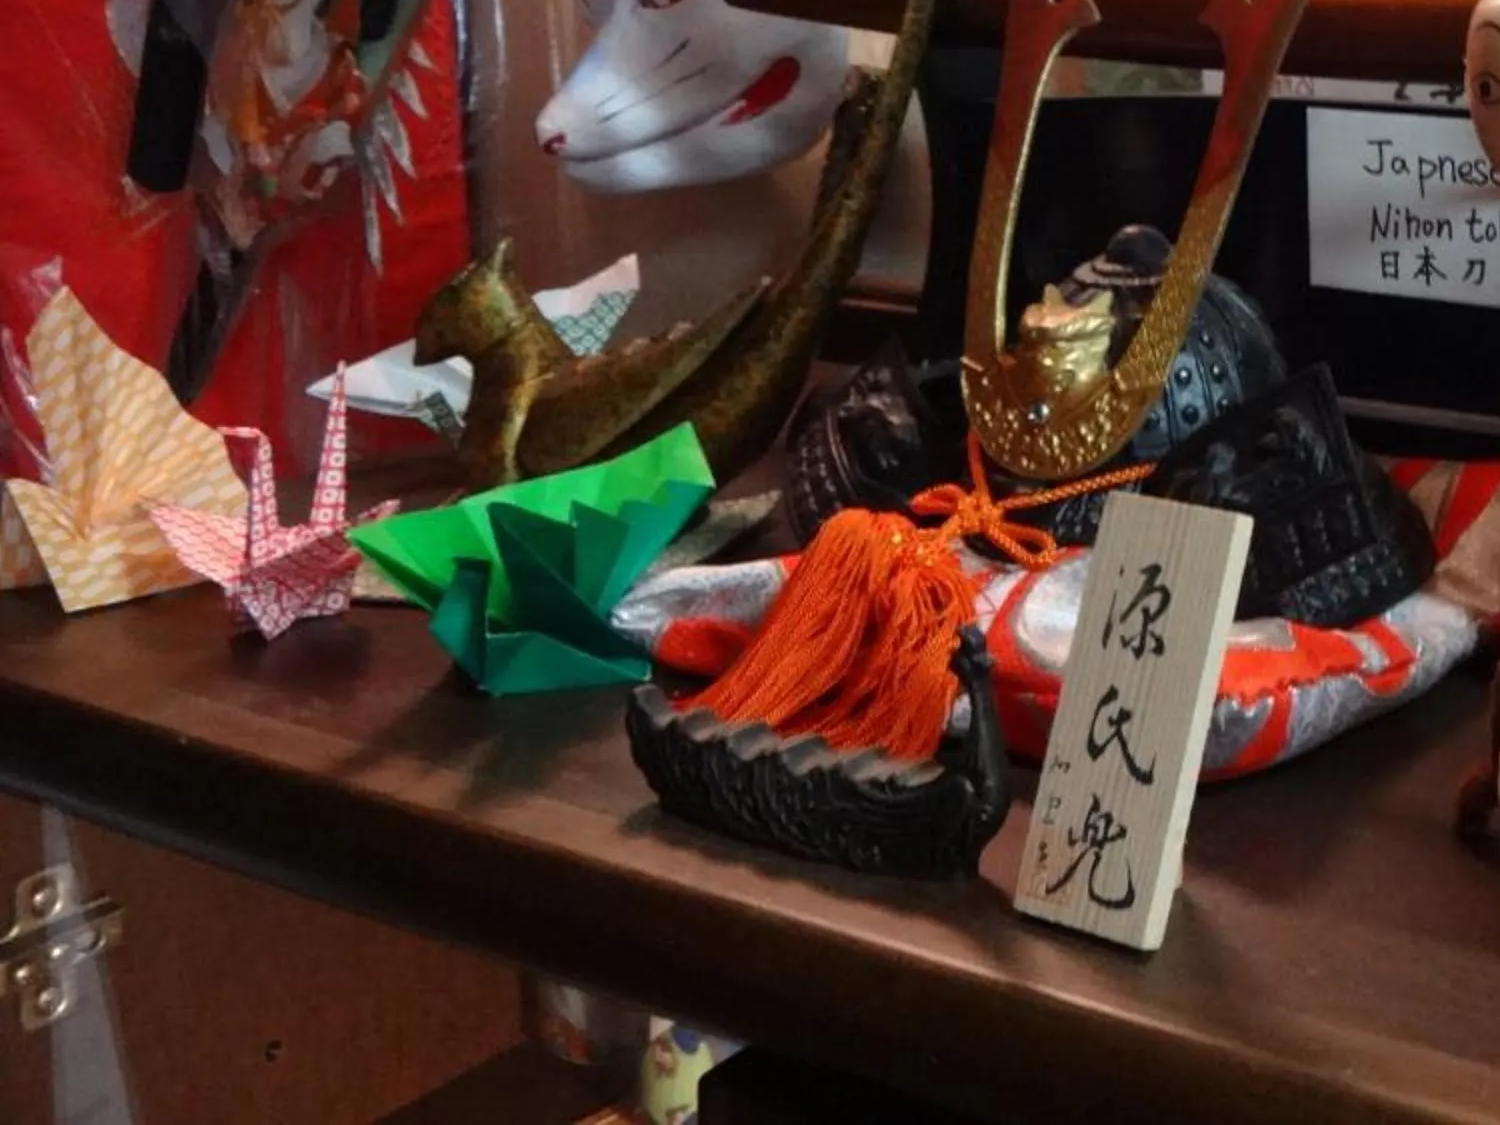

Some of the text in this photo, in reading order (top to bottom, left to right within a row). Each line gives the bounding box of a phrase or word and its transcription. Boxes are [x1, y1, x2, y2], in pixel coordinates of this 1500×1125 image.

[1369, 203, 1454, 243] Nihon
[1379, 245, 1488, 287] 日本刀
